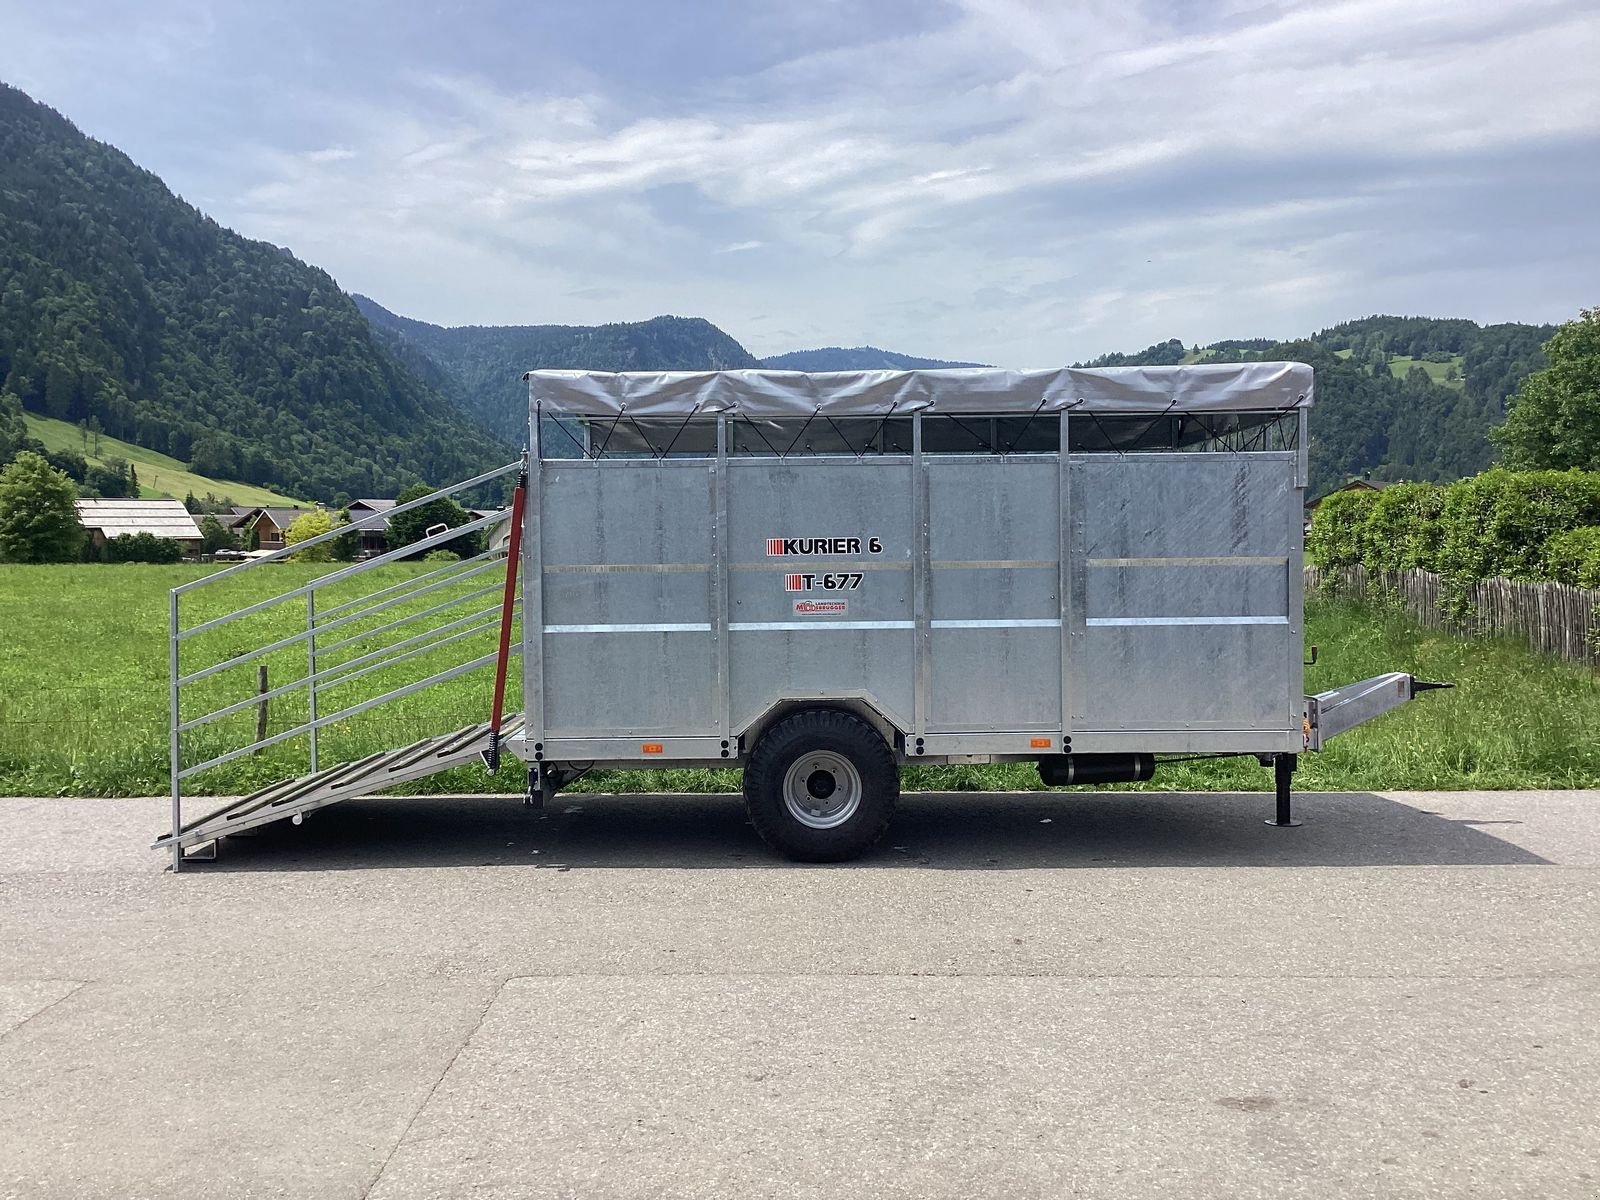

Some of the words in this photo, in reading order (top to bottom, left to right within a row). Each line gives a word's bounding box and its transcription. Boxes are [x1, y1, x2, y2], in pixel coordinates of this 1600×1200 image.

[783, 538, 861, 555] KURIER
[868, 537, 882, 554] 6
[802, 573, 863, 590] T-677
